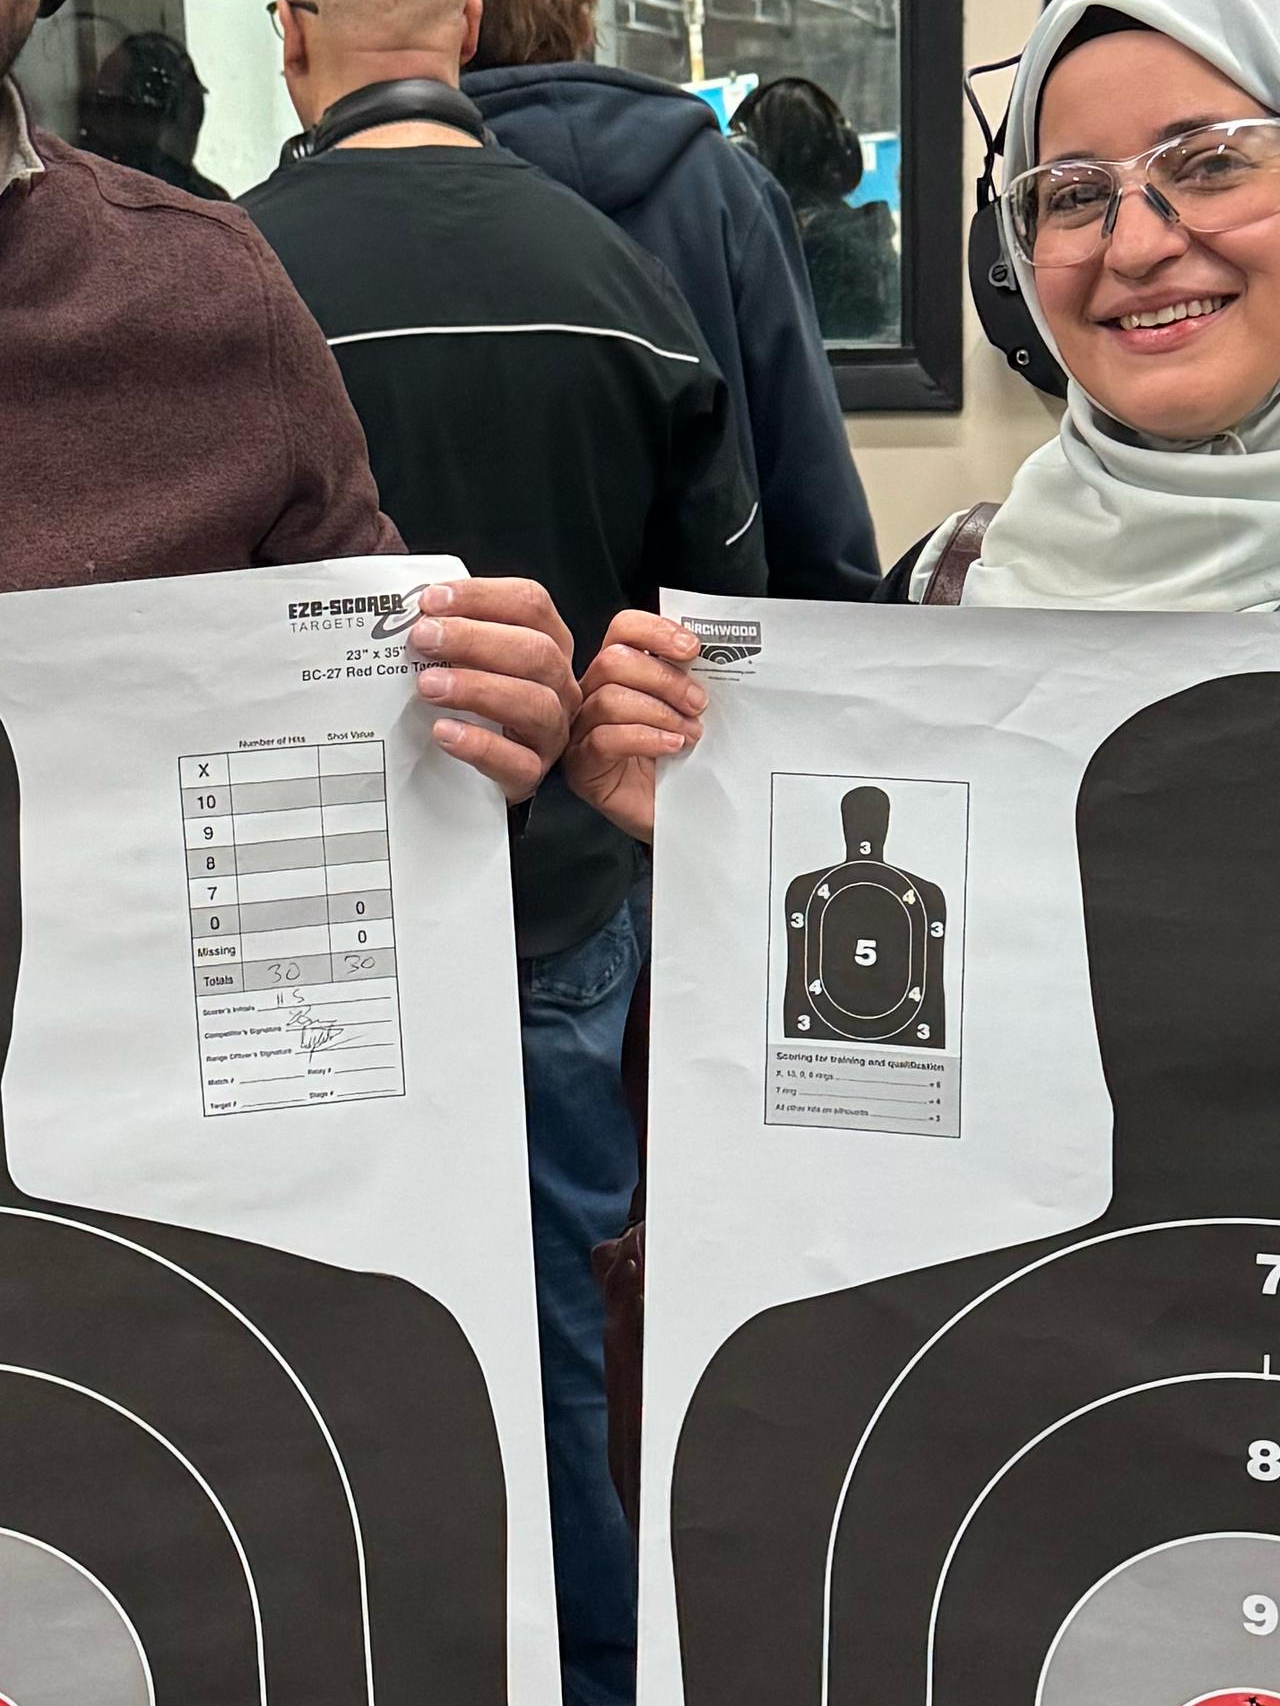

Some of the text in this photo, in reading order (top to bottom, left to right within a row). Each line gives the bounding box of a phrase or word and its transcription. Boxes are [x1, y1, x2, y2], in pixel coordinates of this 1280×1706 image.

[290, 616, 365, 633] TARGETS
[302, 667, 342, 681] BC-27
[346, 666, 372, 677] Red
[377, 663, 408, 675] Core
[198, 763, 210, 778] X
[197, 795, 216, 810] 10
[203, 826, 214, 840] 9
[859, 841, 871, 855] 3
[206, 856, 216, 870] 8
[207, 887, 218, 900] 7
[817, 883, 830, 900] 4
[903, 889, 916, 905] 4
[355, 901, 365, 914] 0
[210, 916, 220, 930] 0
[790, 912, 804, 929] 3
[357, 930, 367, 944] 0
[930, 921, 944, 938] 3
[197, 945, 236, 959] Missing
[854, 939, 878, 967] 5
[344, 954, 376, 973] 30
[267, 961, 301, 983] 30
[203, 975, 234, 987] Totals
[809, 979, 822, 995] 4
[908, 986, 921, 1003] 4
[797, 1014, 811, 1031] 3
[916, 1023, 930, 1040] 3
[1242, 1594, 1280, 1635] 9
